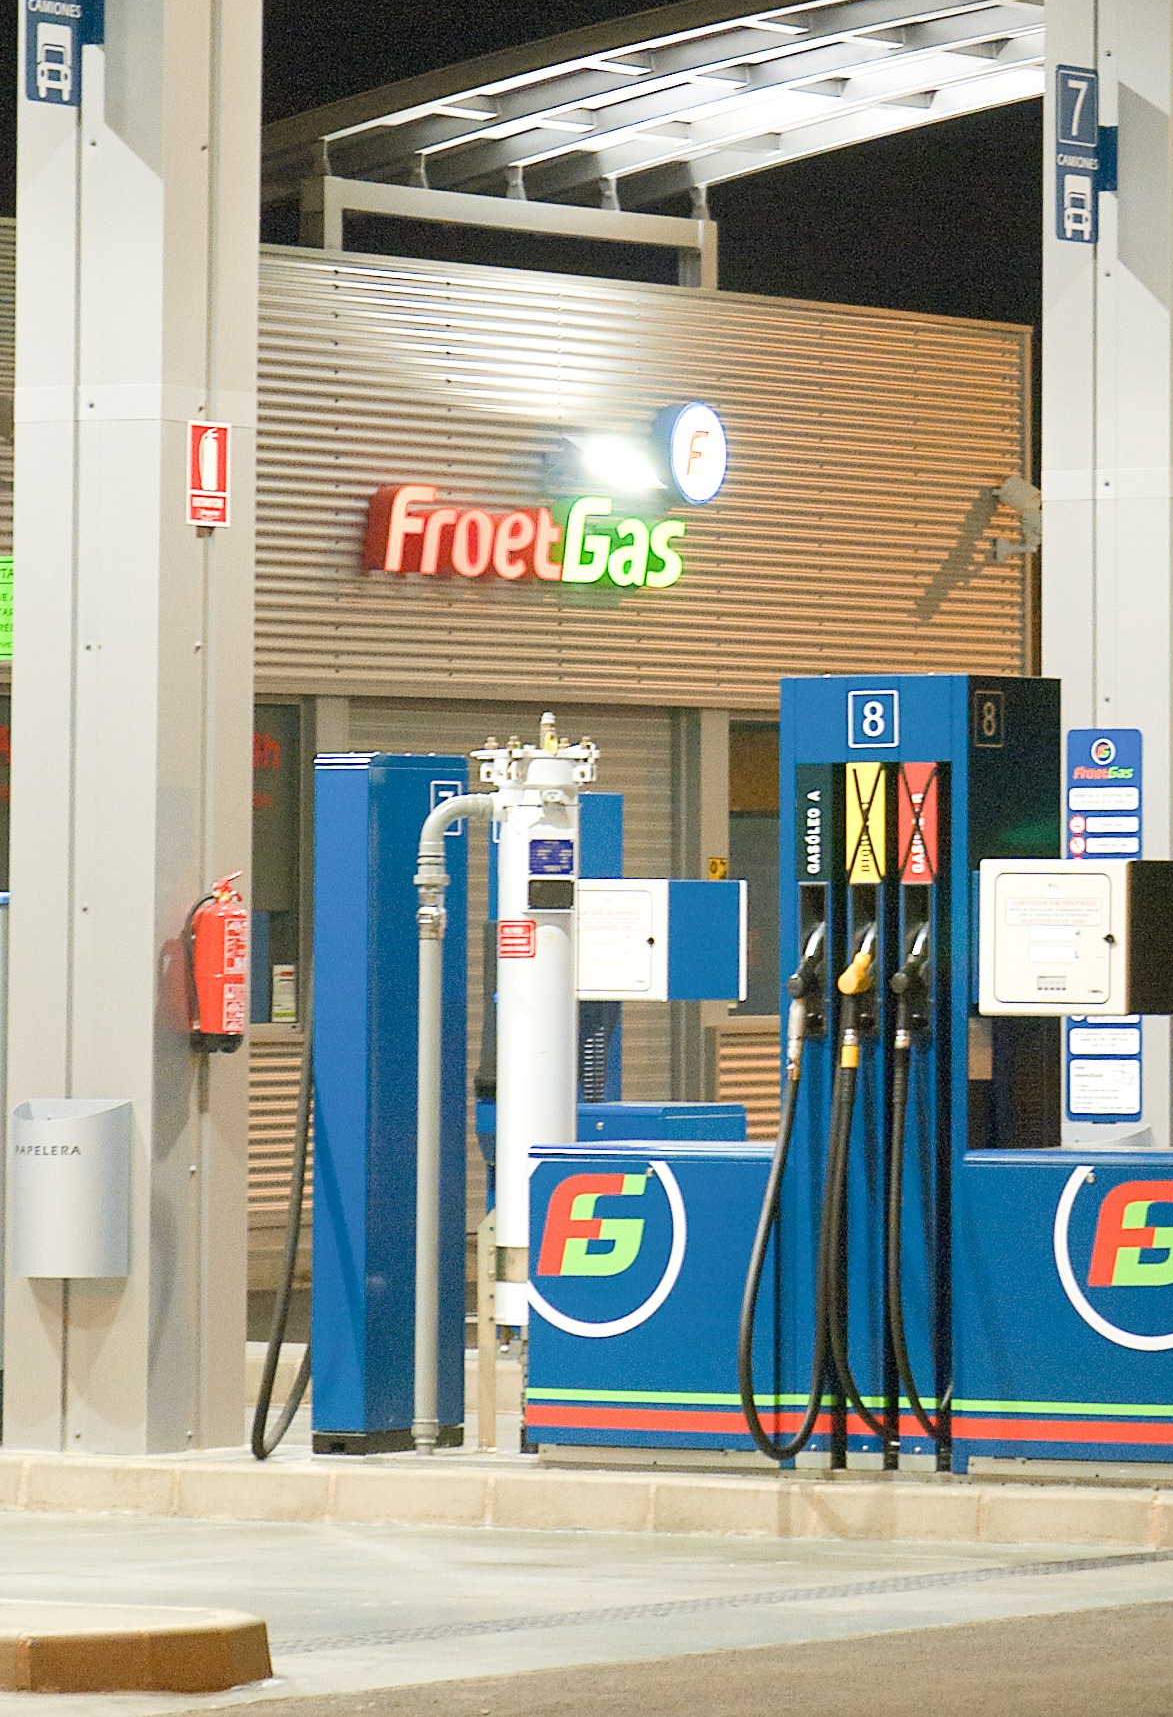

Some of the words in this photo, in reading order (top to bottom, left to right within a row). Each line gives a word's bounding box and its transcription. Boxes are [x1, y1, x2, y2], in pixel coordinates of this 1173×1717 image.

[1067, 79, 1089, 136] 7
[384, 483, 687, 588] FroetGas
[862, 700, 885, 737] 8
[982, 701, 996, 737] 8
[806, 790, 822, 802] A
[804, 807, 822, 874] GASÓLEO
[15, 1144, 82, 1156] PAPELERA
